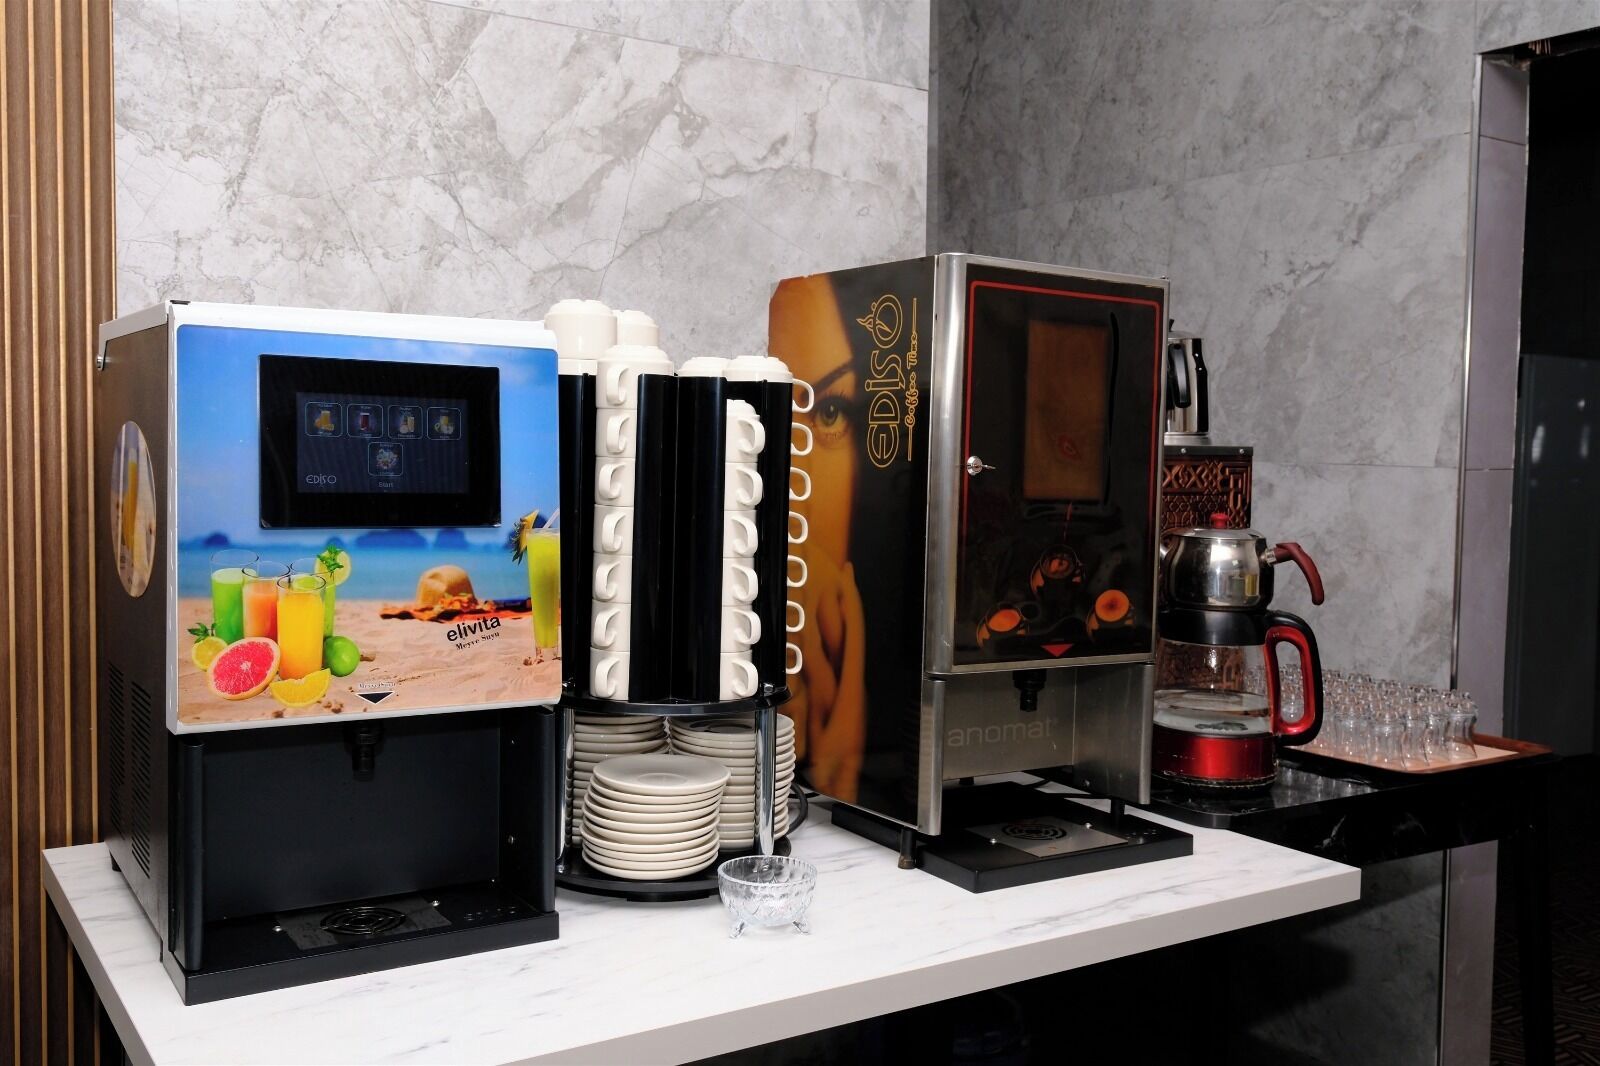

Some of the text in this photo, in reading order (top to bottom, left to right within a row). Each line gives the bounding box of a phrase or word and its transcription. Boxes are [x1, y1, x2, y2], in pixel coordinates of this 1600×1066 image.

[904, 332, 919, 427] Coffee Time
[447, 616, 502, 642] elivita
[455, 631, 501, 651] Meyve Suyu
